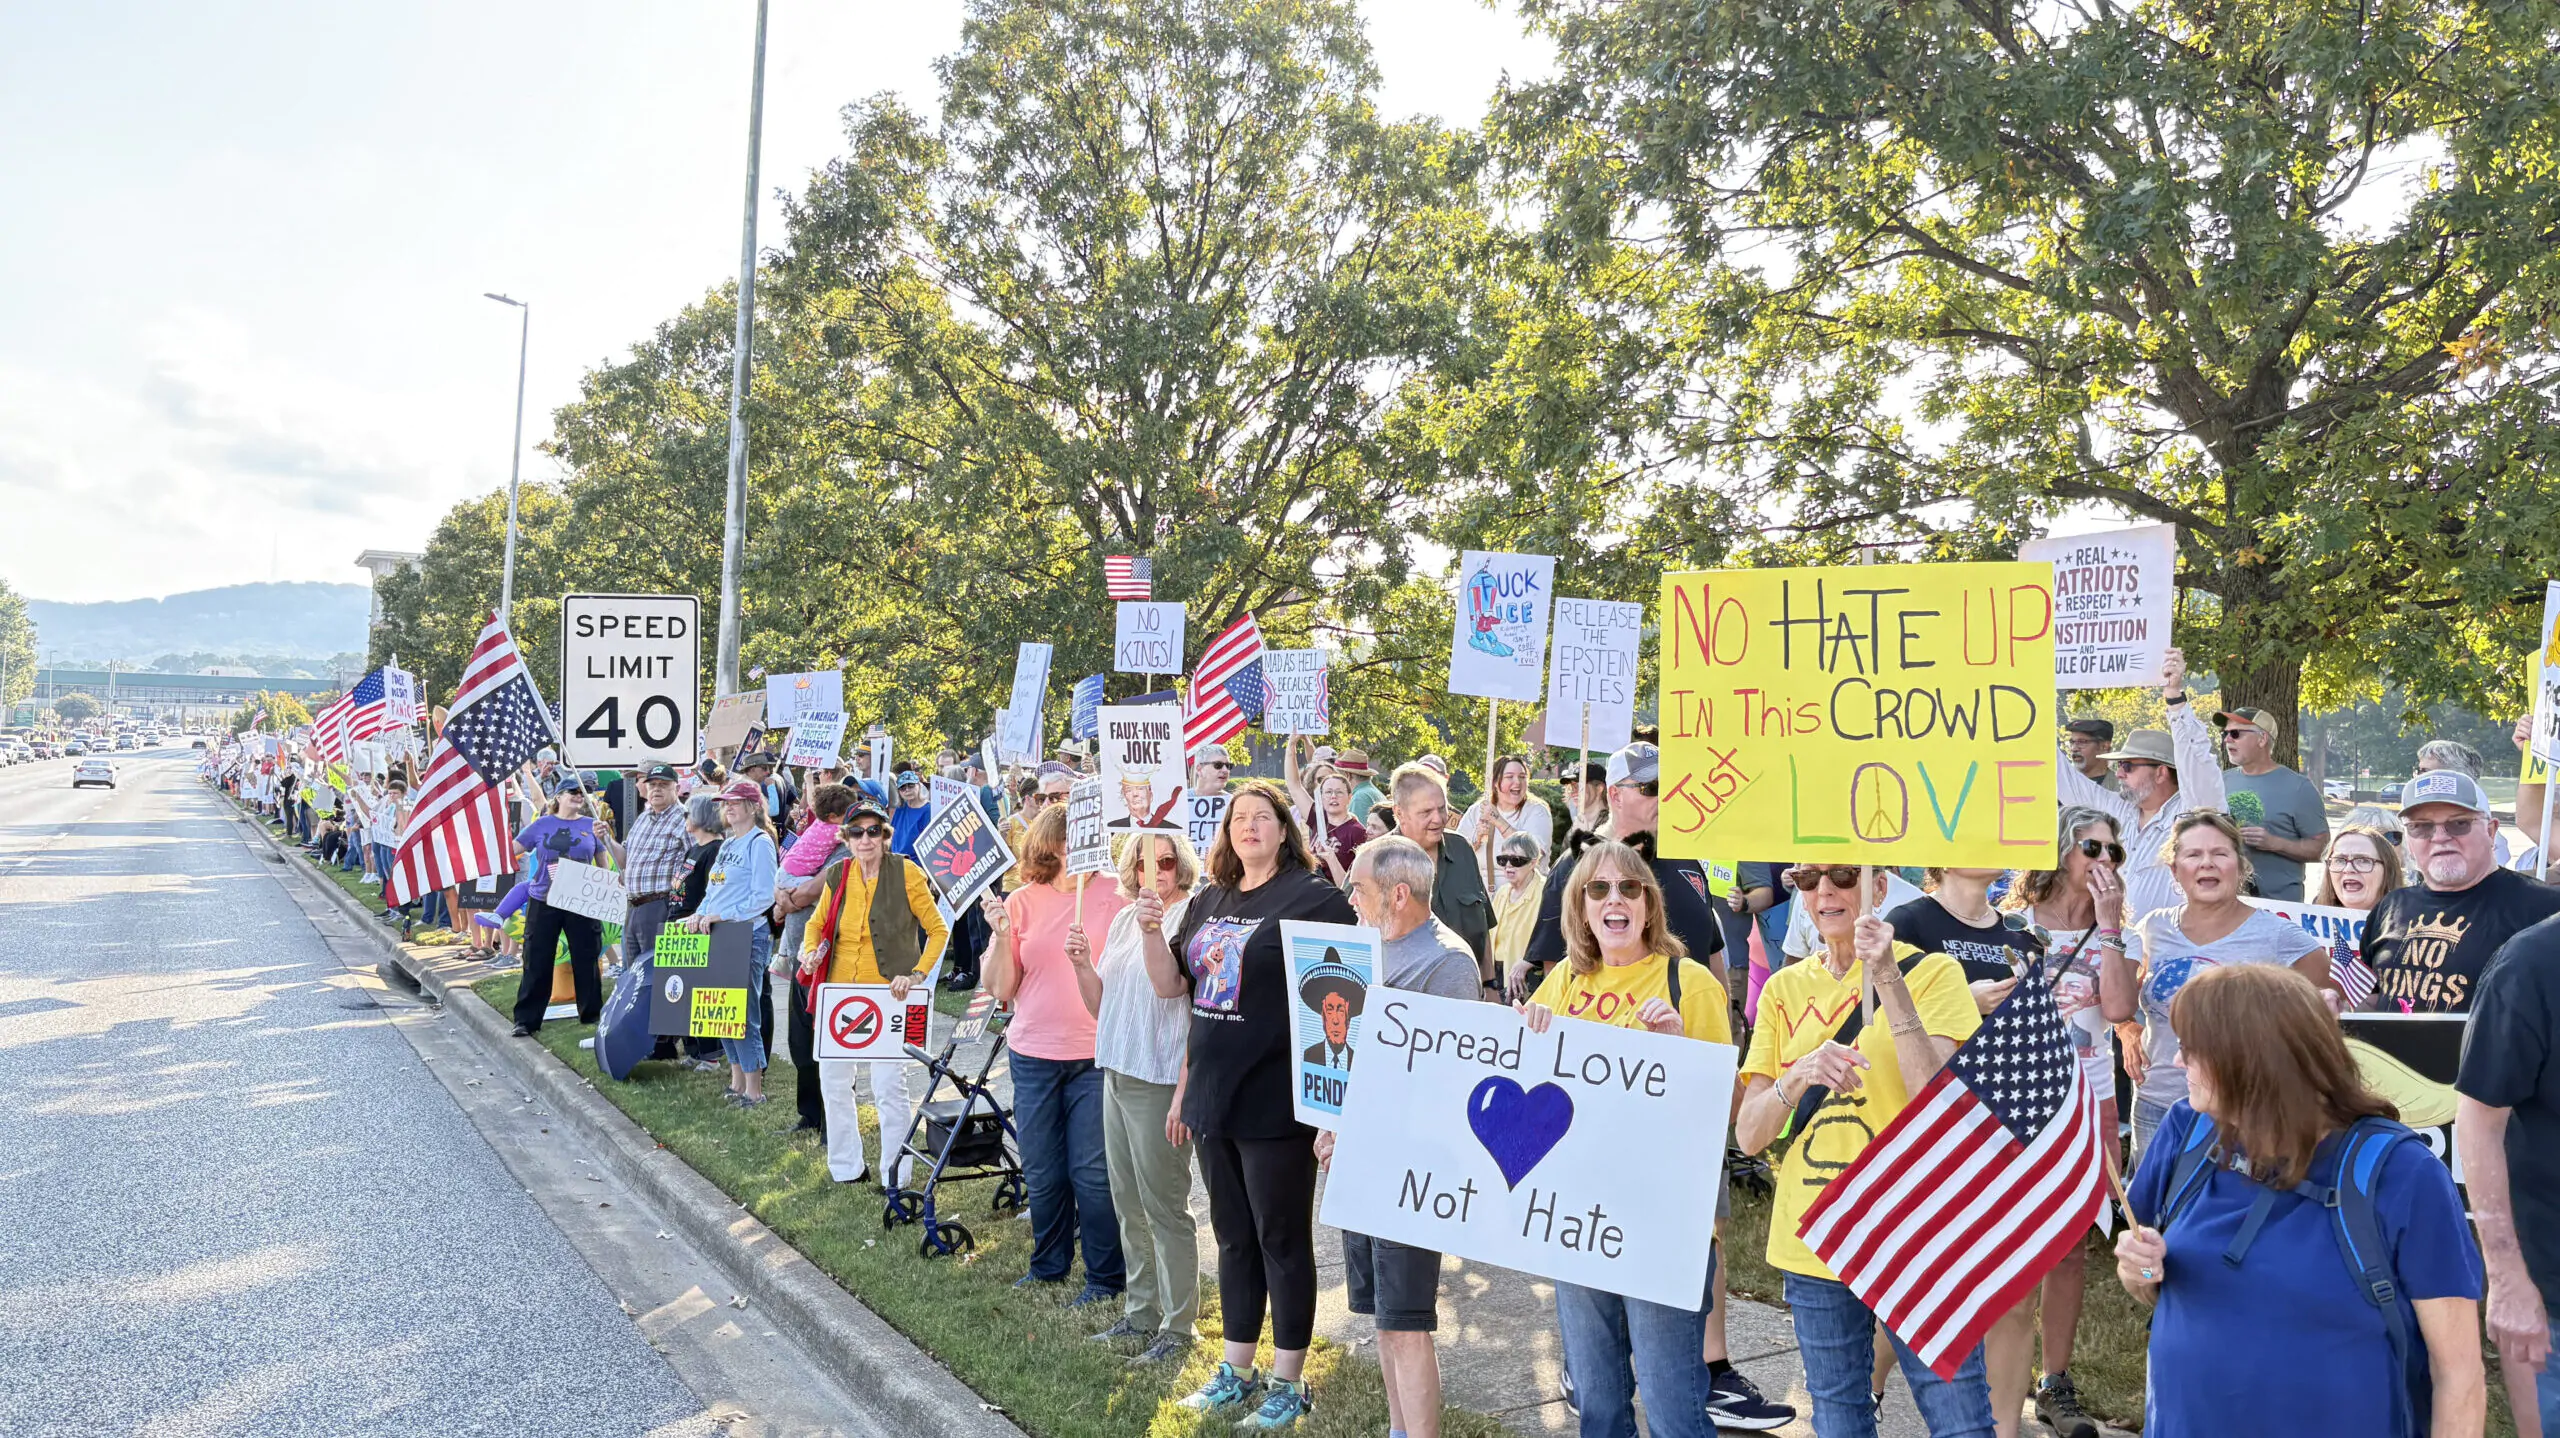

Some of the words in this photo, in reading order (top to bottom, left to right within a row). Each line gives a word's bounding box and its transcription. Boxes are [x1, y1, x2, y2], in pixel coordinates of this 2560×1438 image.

[2076, 547, 2107, 566] REAL
[1482, 568, 1540, 602] FUCK
[2054, 565, 2139, 597] ATRIOTS
[1496, 601, 1533, 623] ICE
[2066, 594, 2113, 611] RESPECT
[576, 615, 687, 638] SPEED
[1137, 607, 1160, 631] NO
[1560, 602, 1638, 630] RELEASE
[1674, 583, 1749, 670] NO
[1769, 578, 1940, 674] HATE
[1964, 584, 2052, 667] UP
[2079, 611, 2099, 620] OUR
[1120, 630, 1175, 667] KINGS!
[1581, 629, 1607, 646] THE
[2080, 645, 2095, 654] AND
[588, 656, 674, 679] LIMIT
[1264, 653, 1282, 672] MAD
[1283, 653, 1295, 672] AS
[1299, 652, 1320, 672] HELL
[1560, 646, 1635, 677] EPSTEIN
[2081, 656, 2096, 673] OF
[2100, 654, 2128, 673] LAW
[795, 688, 813, 702] NO
[1277, 677, 1313, 692] BECAUSE
[1559, 674, 1625, 705] FILES
[1275, 695, 1283, 709] I
[1287, 695, 1313, 709] LOVE
[1670, 689, 1713, 739] IN
[1733, 688, 1821, 737] This
[1830, 677, 2036, 742] CROWD
[575, 695, 681, 749] 40
[800, 711, 808, 720] IN
[809, 711, 839, 722] AMERICA
[1267, 712, 1287, 729] THIS
[1292, 712, 1321, 730] PLACE
[1110, 722, 1170, 741] FAUX-KING
[795, 738, 833, 751] DEMOCRACY
[1122, 741, 1162, 764] JOKE
[792, 755, 823, 766] PRESIDENT
[1662, 746, 1750, 833] Just
[1788, 754, 2052, 846] LOVE
[1069, 796, 1100, 821] HANDS
[920, 817, 952, 858] HANDS
[950, 797, 971, 820] OFF
[951, 810, 982, 845] OUR
[1068, 816, 1100, 851] OFF!
[583, 866, 618, 886] LOV
[948, 847, 1001, 904] DEMOCRACY
[1713, 865, 1730, 880] the
[581, 882, 621, 905] OUR
[658, 938, 698, 951] SEMPER
[1946, 950, 1972, 960] SHE
[2401, 939, 2448, 968] NO
[656, 952, 707, 967] TYRANNIS
[697, 990, 727, 1004] THUS
[2378, 968, 2468, 1005] KINGS
[694, 1006, 737, 1020] ALWAYS
[890, 1014, 903, 1033] NO
[1227, 1014, 1245, 1022] me.
[692, 1022, 703, 1036] TO
[708, 1022, 746, 1037] TYRANTS
[905, 1005, 926, 1047] KINGS
[1377, 1002, 1525, 1073] Spread
[1553, 1031, 1667, 1098] Love
[1398, 1169, 1478, 1223] Not
[1522, 1188, 1624, 1259] Hate
